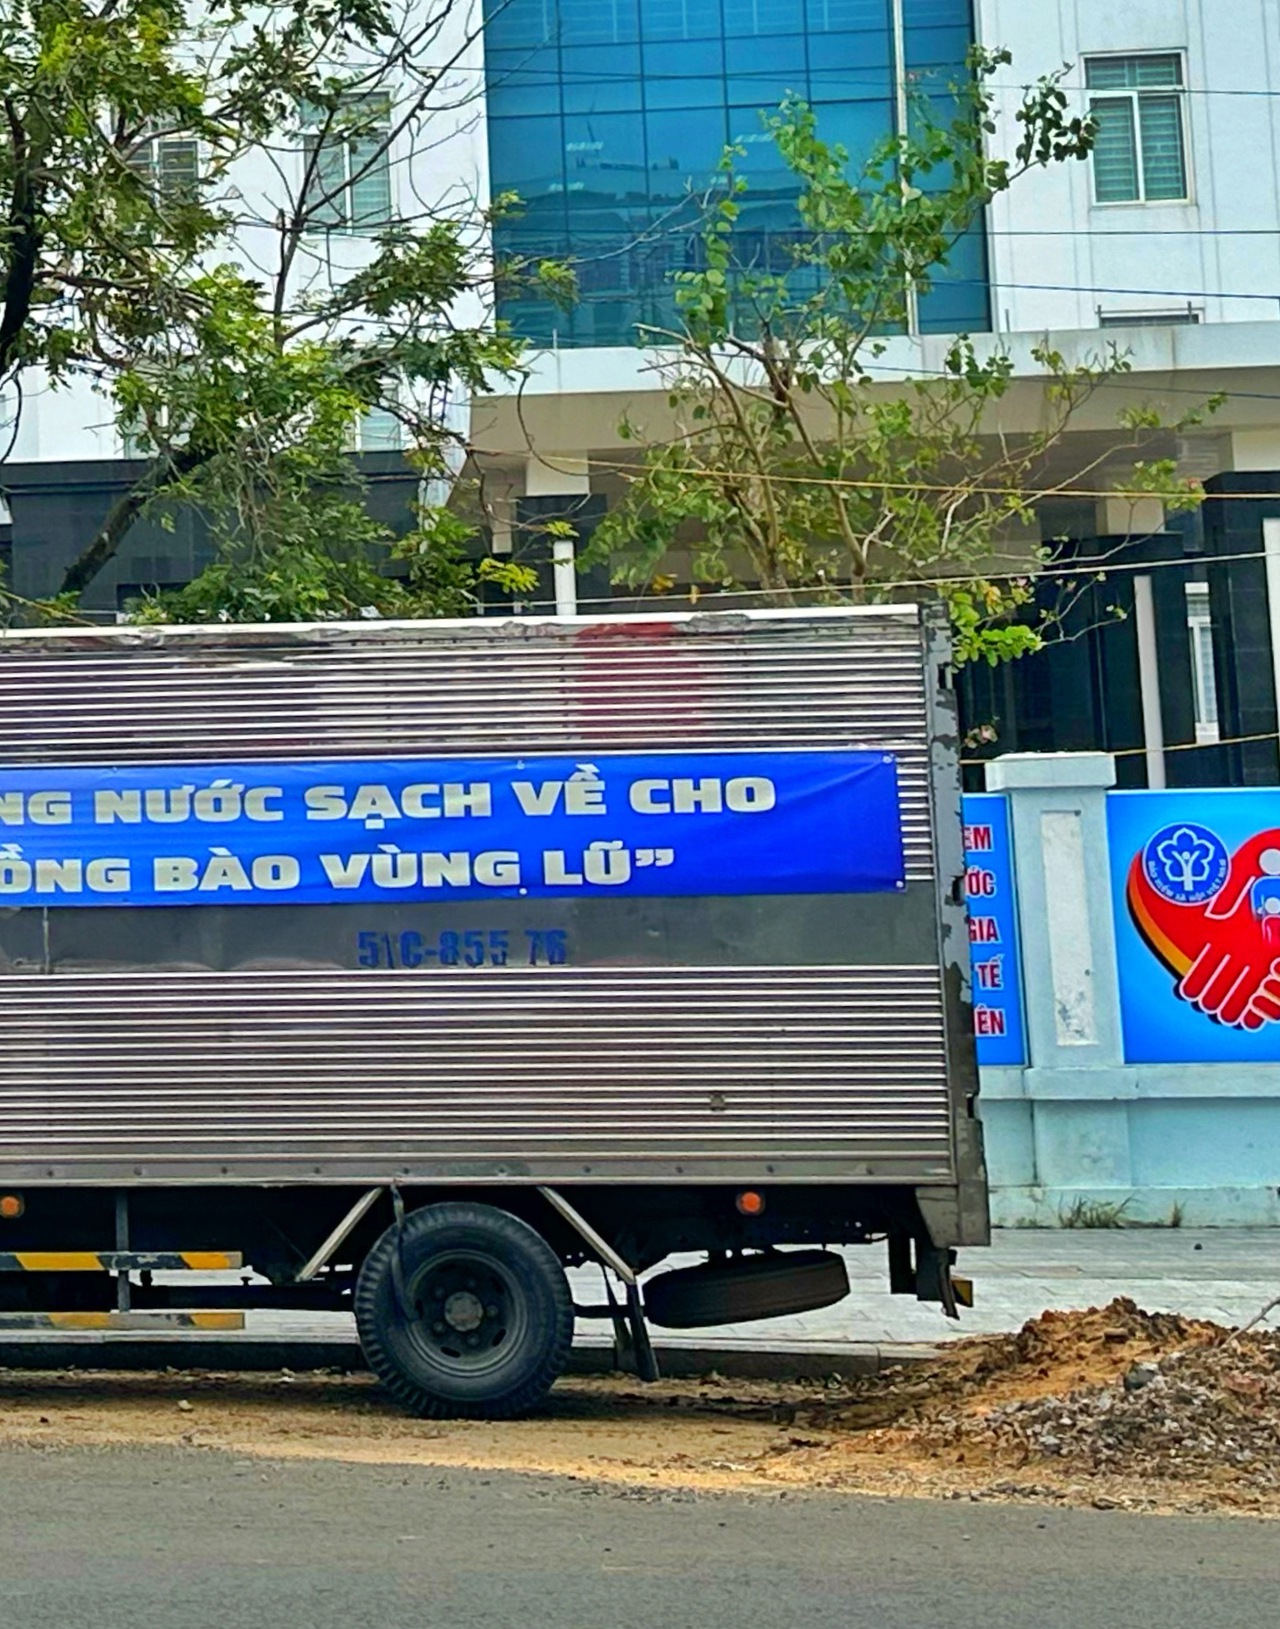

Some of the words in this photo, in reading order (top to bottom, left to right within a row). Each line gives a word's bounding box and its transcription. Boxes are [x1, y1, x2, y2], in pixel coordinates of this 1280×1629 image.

[94, 779, 285, 824] NƯỚC
[305, 781, 492, 830] SẠCH
[511, 763, 608, 817] VỀ
[629, 776, 776, 814] CHO
[154, 847, 301, 892] BÀO
[320, 844, 521, 889] VÙNG
[966, 865, 997, 897] ỚC
[976, 953, 1005, 990] TẾ
[975, 1003, 1007, 1036] ÊN
